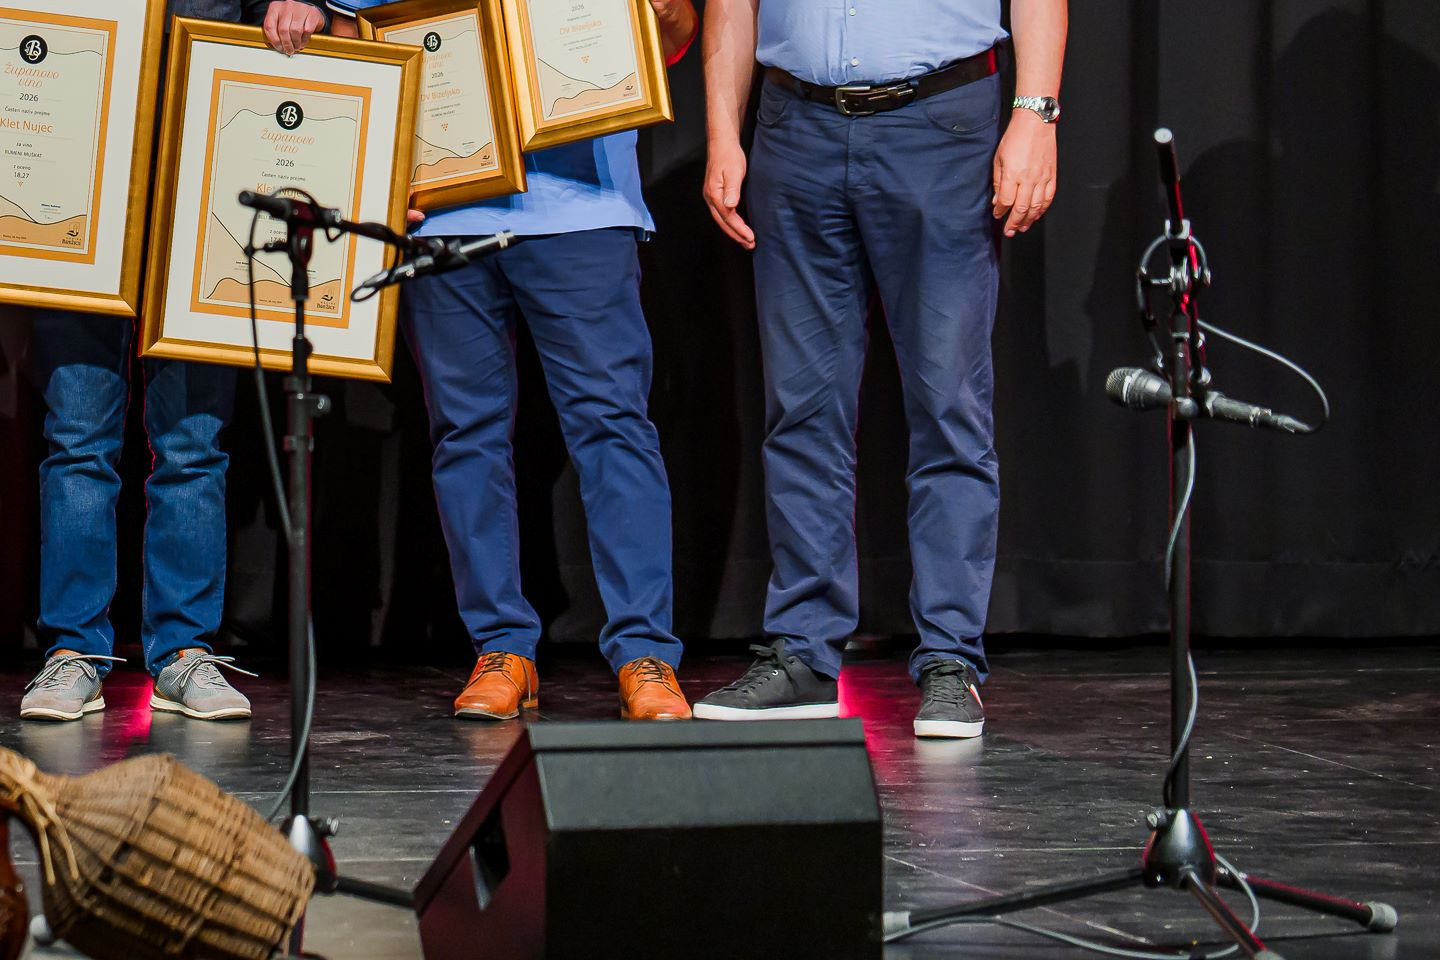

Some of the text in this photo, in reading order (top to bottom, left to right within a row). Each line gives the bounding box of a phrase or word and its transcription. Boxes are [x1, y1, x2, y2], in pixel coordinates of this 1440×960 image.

[4, 63, 60, 79] Županovo
[18, 78, 42, 87] vino
[20, 93, 38, 102] 2026
[432, 88, 460, 100] Bizeljsko
[0, 118, 53, 133] Klet Nujec
[261, 129, 316, 145] Županovo
[274, 144, 299, 153] vino
[276, 159, 294, 167] 2026
